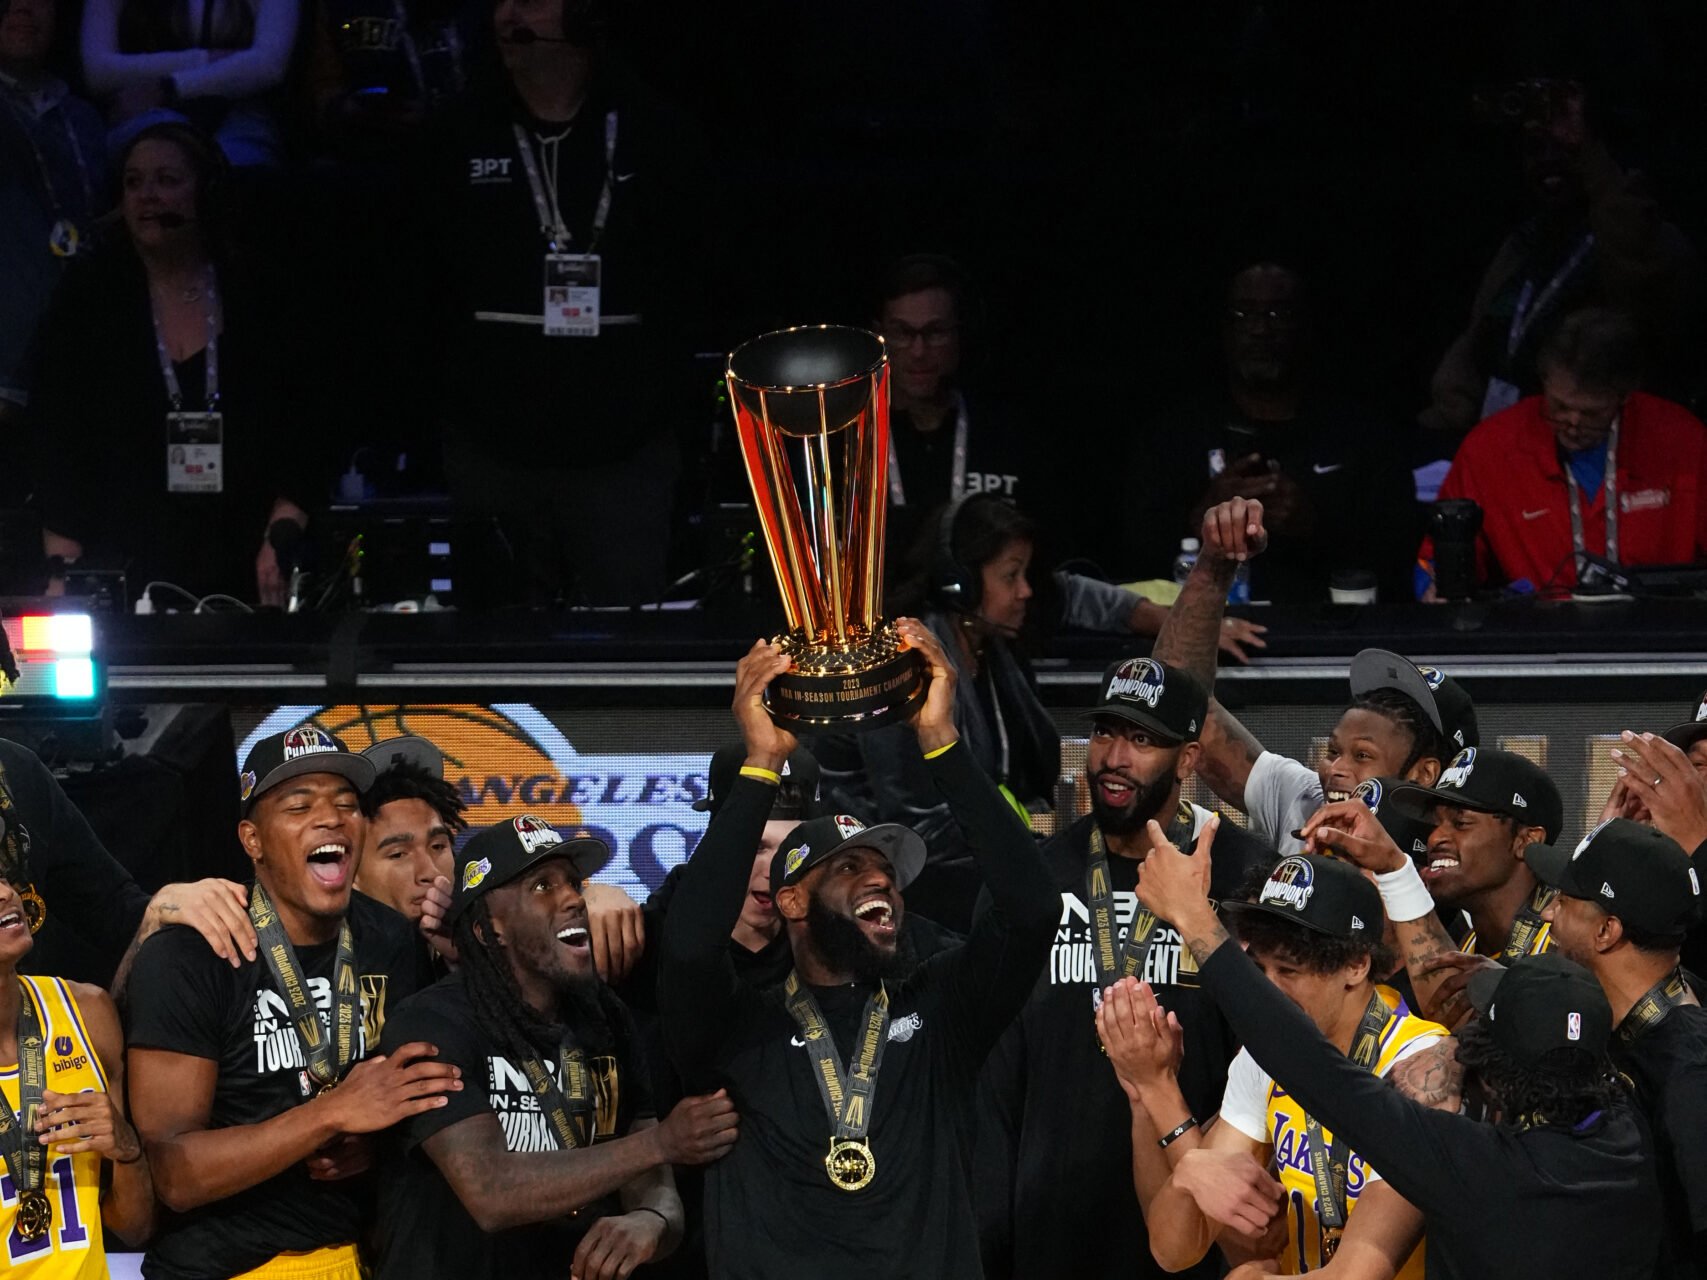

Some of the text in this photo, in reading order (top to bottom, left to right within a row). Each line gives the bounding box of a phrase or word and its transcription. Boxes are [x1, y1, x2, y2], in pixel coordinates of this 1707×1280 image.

[470, 158, 512, 178] 3PT
[966, 472, 1019, 495] 3PT
[794, 690, 835, 703] IN-SEASON
[835, 682, 882, 702] TOURNAMENT
[842, 678, 861, 690] 2023
[1106, 676, 1165, 708] CHAMPIONS
[1060, 891, 1139, 925] NB
[1260, 877, 1314, 910] CHAMPIONS
[1095, 907, 1116, 972] 2023 CHAMPIONS
[270, 944, 307, 1008] 2023 CHAMPIONS
[1051, 943, 1182, 985] TOURENT
[337, 1003, 353, 1066] 2023 CHAMPIONS
[870, 1011, 884, 1031] 2023
[888, 1016, 922, 1040] AKERS
[53, 1055, 88, 1073] bibigo
[820, 1057, 844, 1105] CHAMPIONS
[1274, 1111, 1365, 1198] LAKS
[1313, 1151, 1335, 1218] 2023 CHAMPIONS
